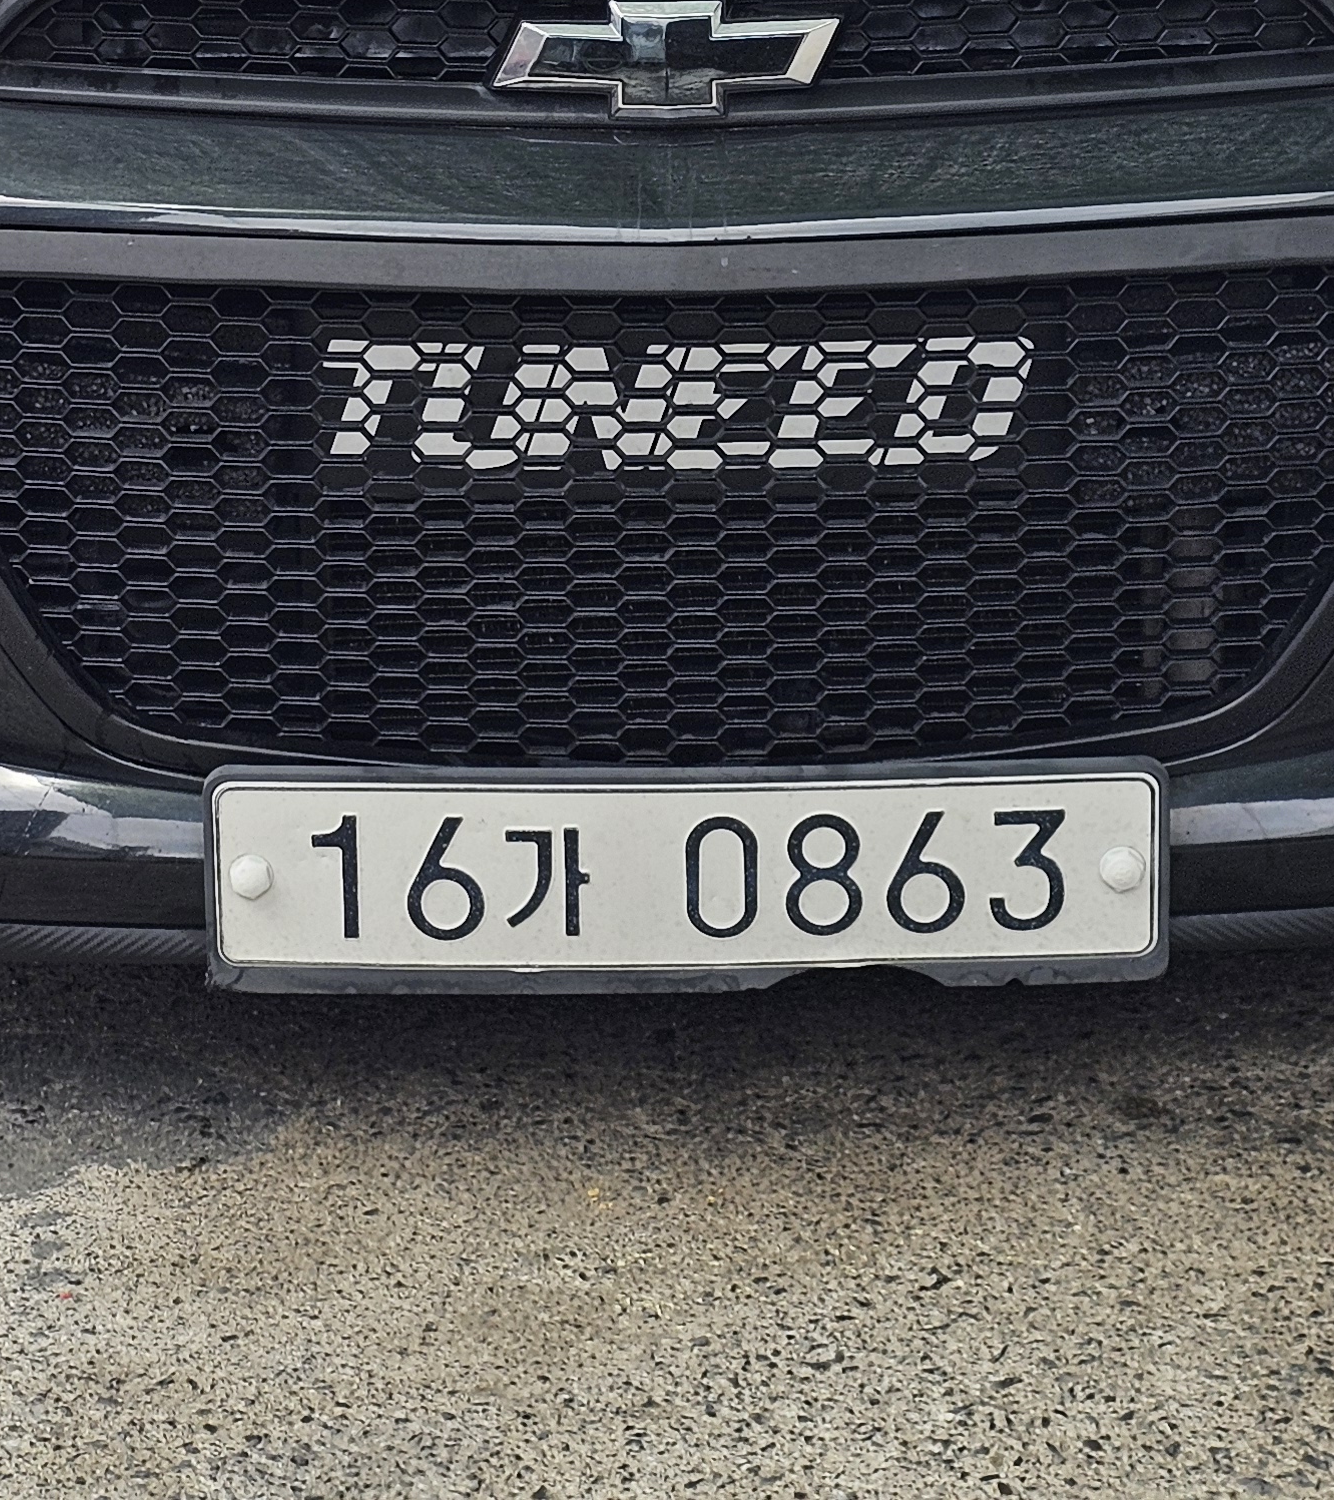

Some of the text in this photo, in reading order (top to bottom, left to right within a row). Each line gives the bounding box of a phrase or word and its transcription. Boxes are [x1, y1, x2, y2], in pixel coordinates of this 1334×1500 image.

[321, 336, 1035, 471] TUNEED
[309, 807, 1067, 941] 16가 0863
